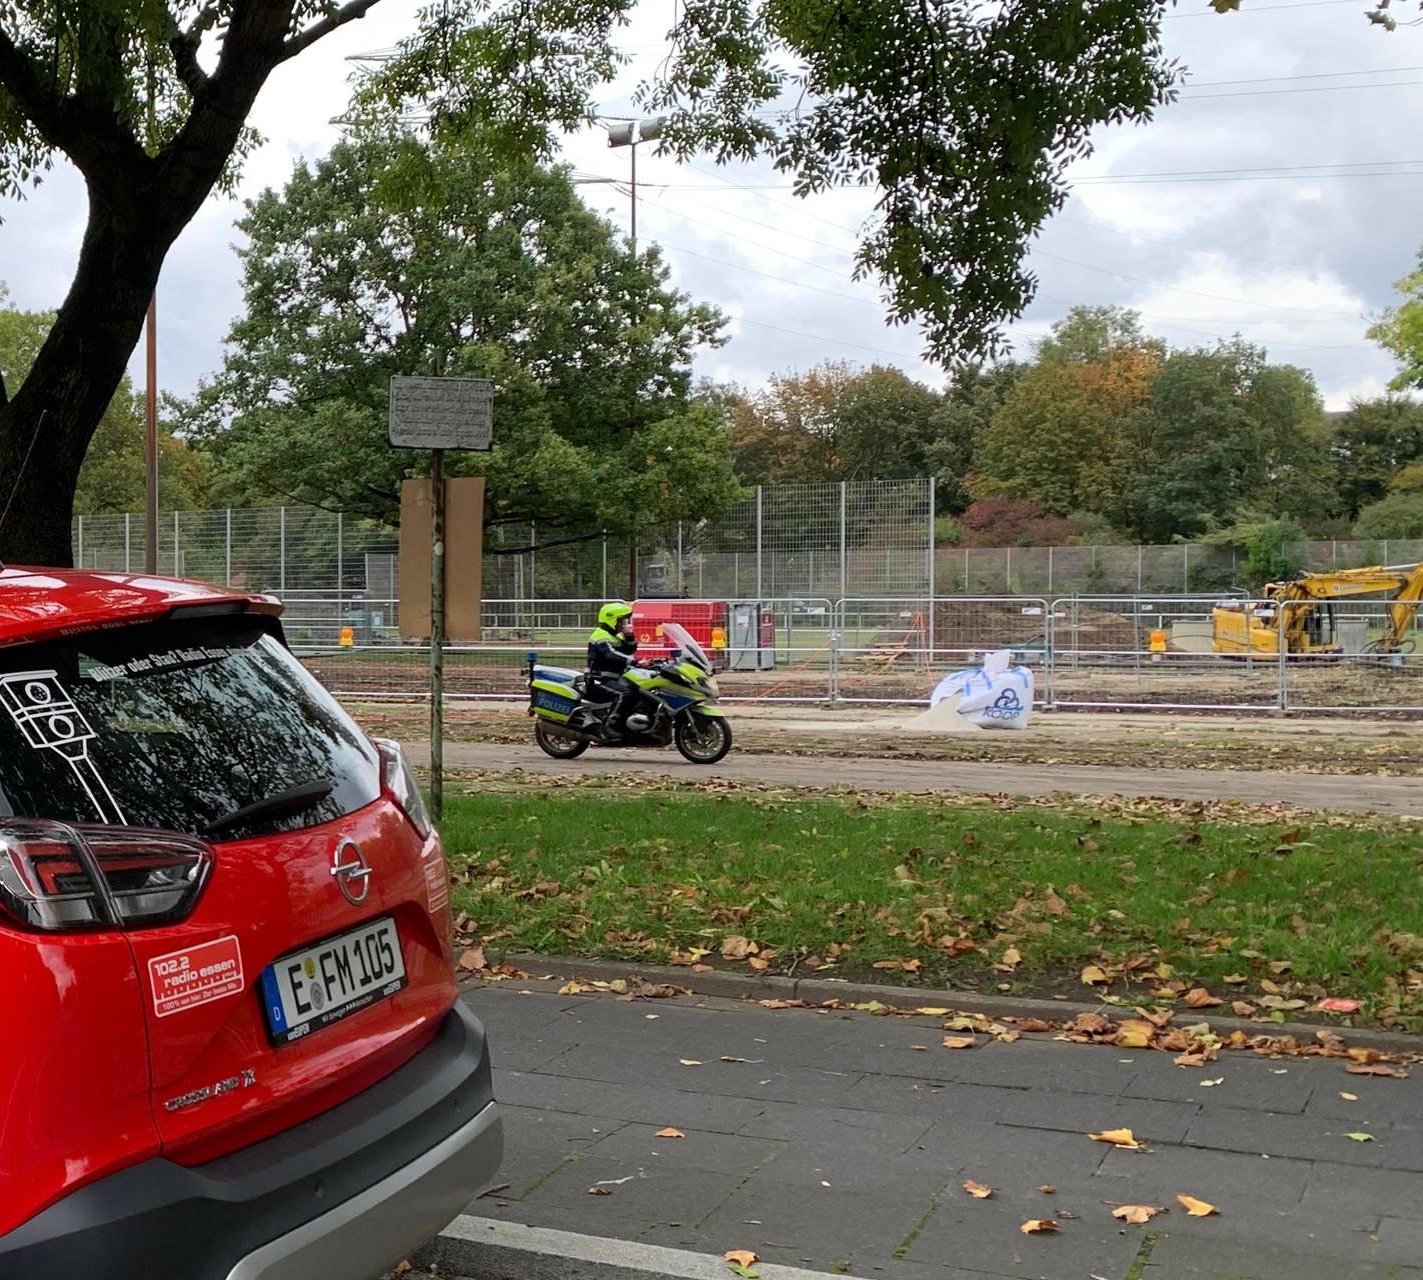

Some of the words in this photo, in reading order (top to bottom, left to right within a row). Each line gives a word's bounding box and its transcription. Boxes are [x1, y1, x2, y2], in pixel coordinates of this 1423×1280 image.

[88, 663, 128, 682] Blitzer
[127, 658, 153, 673] oder
[149, 651, 179, 668] Stau?
[154, 956, 190, 976] 102.2
[164, 969, 198, 988] radio
[199, 959, 236, 977] essen
[287, 963, 313, 1016] E
[273, 1006, 281, 1021] D
